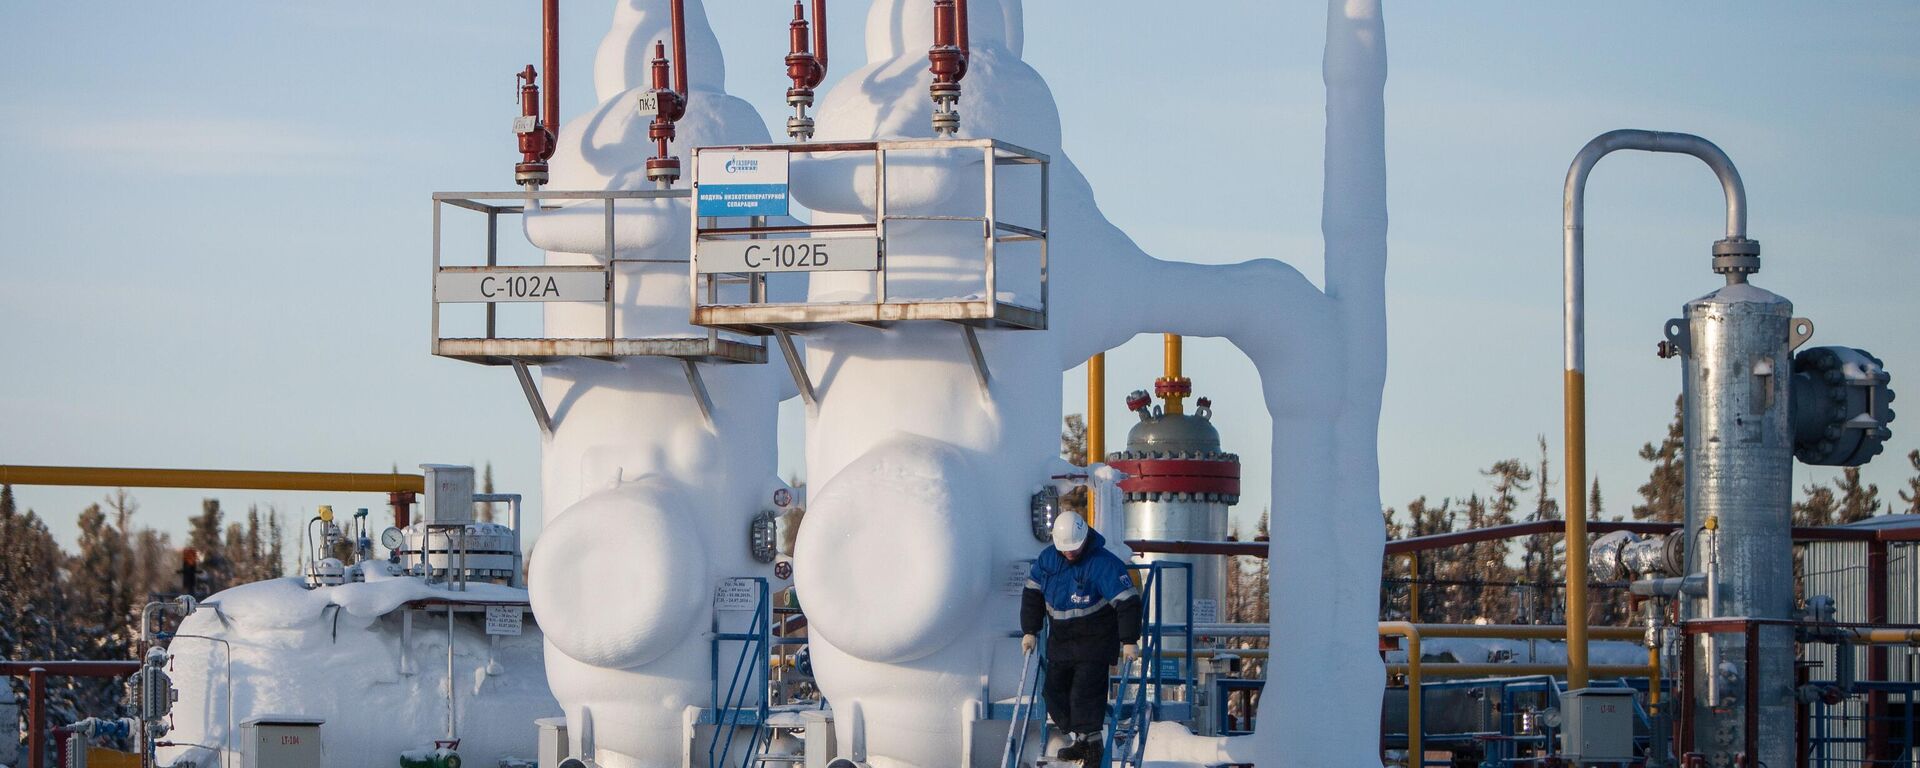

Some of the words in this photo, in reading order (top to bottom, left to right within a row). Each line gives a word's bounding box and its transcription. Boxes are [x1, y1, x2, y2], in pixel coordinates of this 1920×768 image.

[639, 97, 656, 111] ПК-2
[745, 244, 829, 268] С-102Б
[481, 276, 560, 298] С-102А
